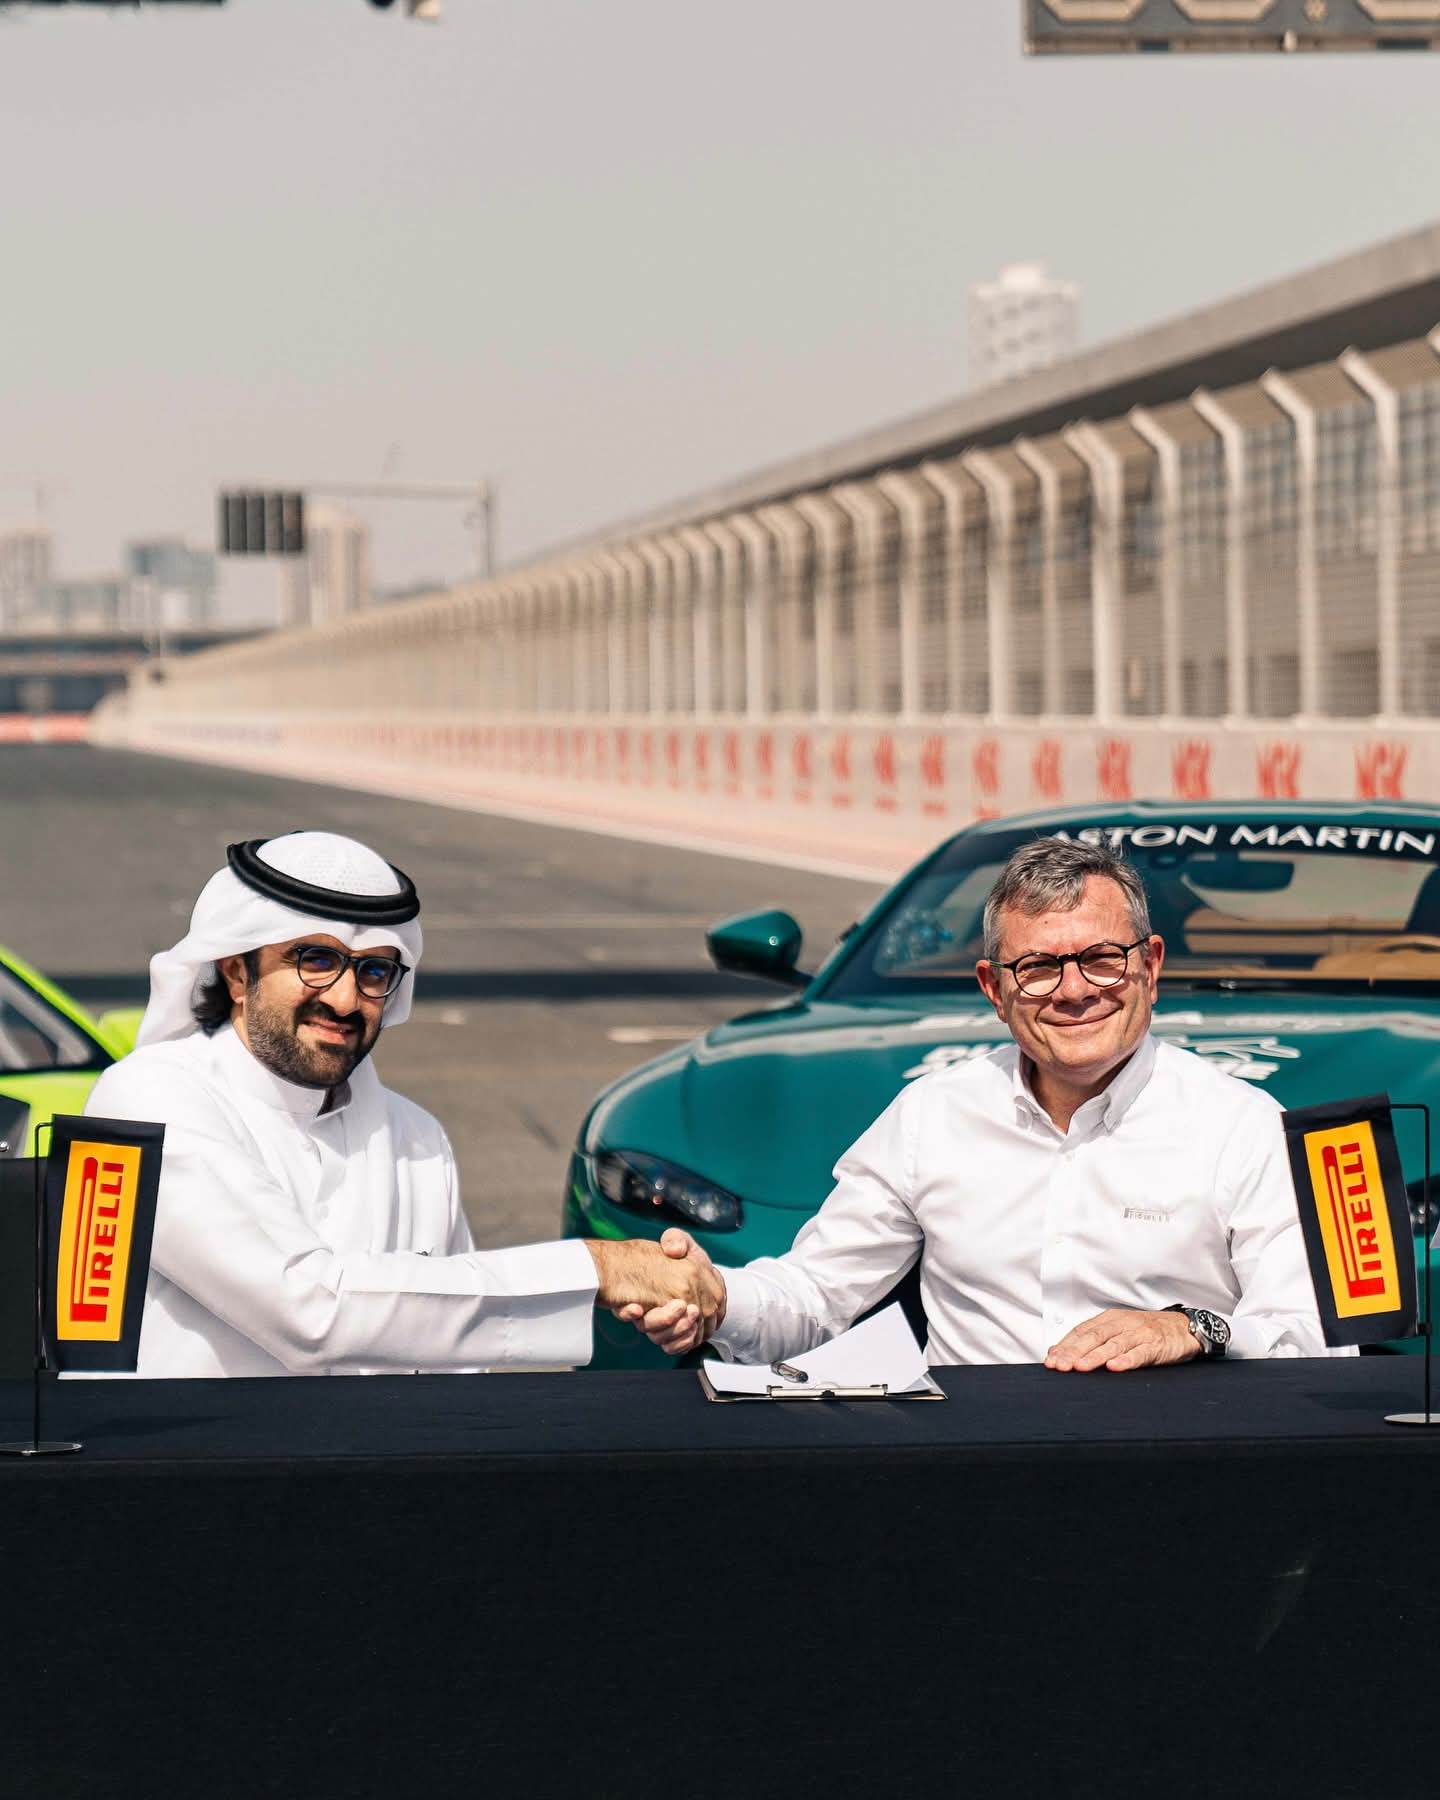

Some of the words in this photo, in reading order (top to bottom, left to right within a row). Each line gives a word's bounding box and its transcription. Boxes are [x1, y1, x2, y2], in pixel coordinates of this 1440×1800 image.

[1230, 824, 1435, 855] MARTIN
[70, 1156, 125, 1323] PIRELLI
[1321, 1142, 1386, 1299] PIRELLI
